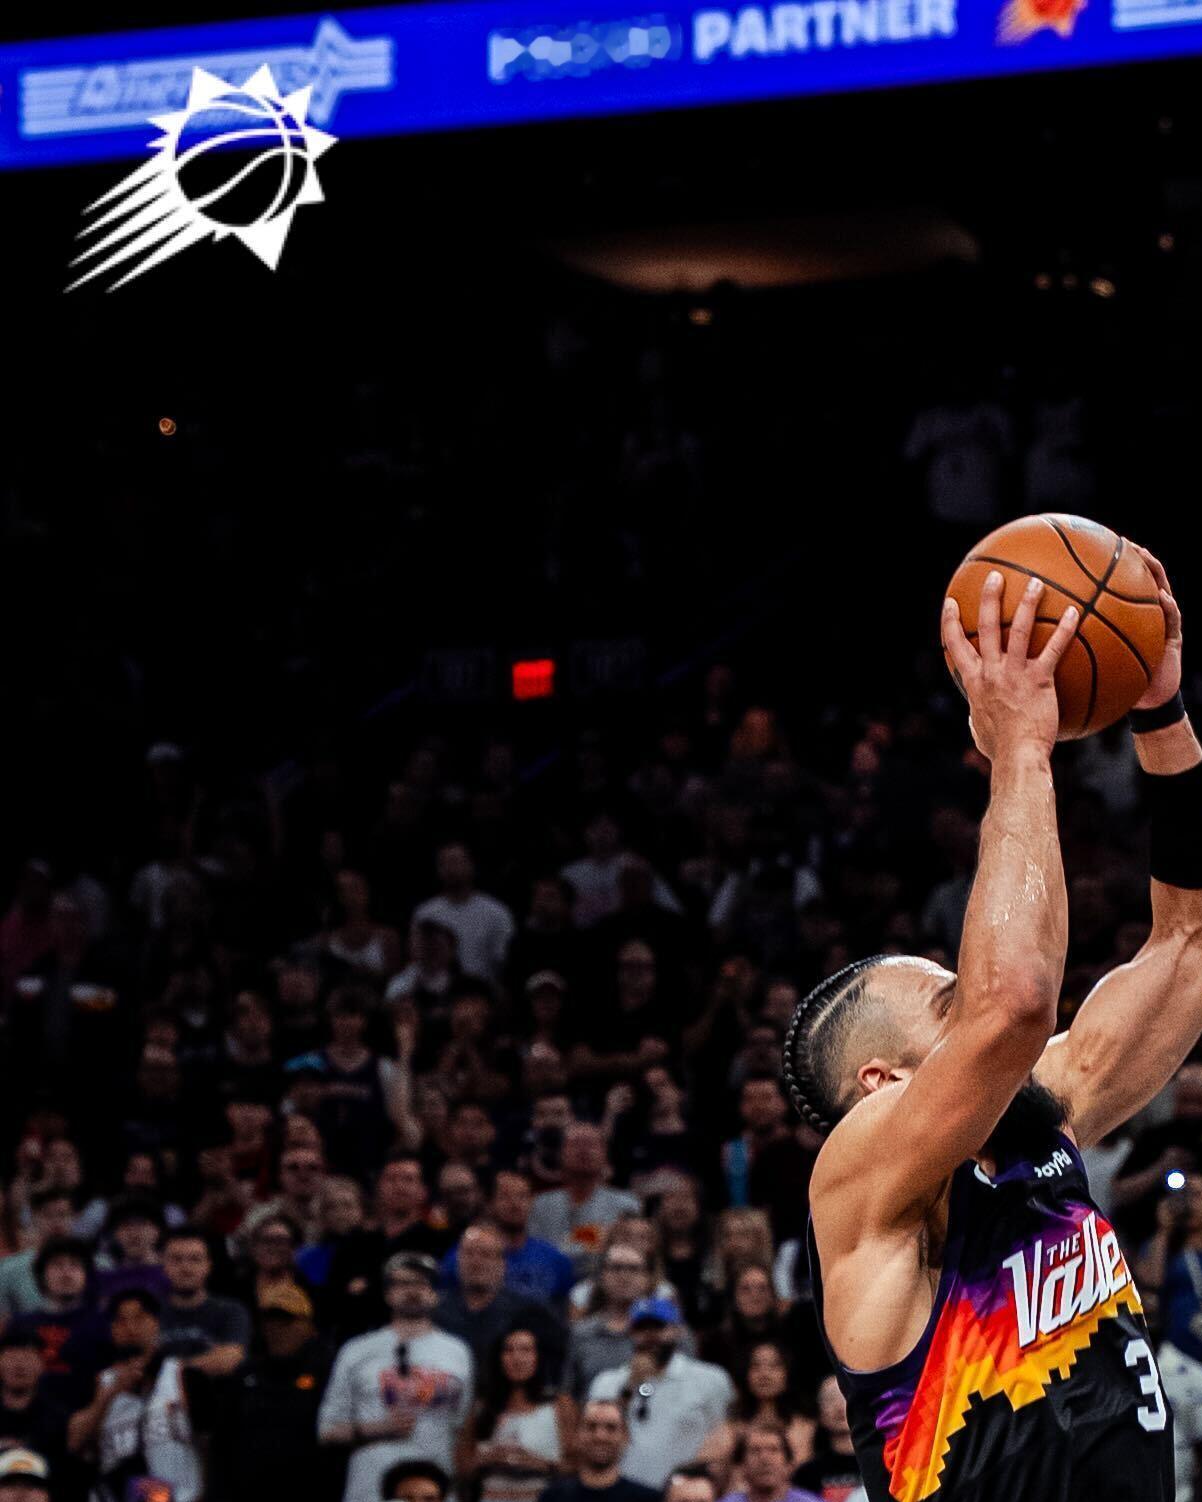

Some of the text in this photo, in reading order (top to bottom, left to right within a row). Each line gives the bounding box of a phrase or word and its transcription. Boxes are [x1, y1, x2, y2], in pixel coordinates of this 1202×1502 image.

[693, 0, 958, 62] PARTNER
[1046, 1231, 1082, 1266] THE
[1124, 1338, 1167, 1432] 3
